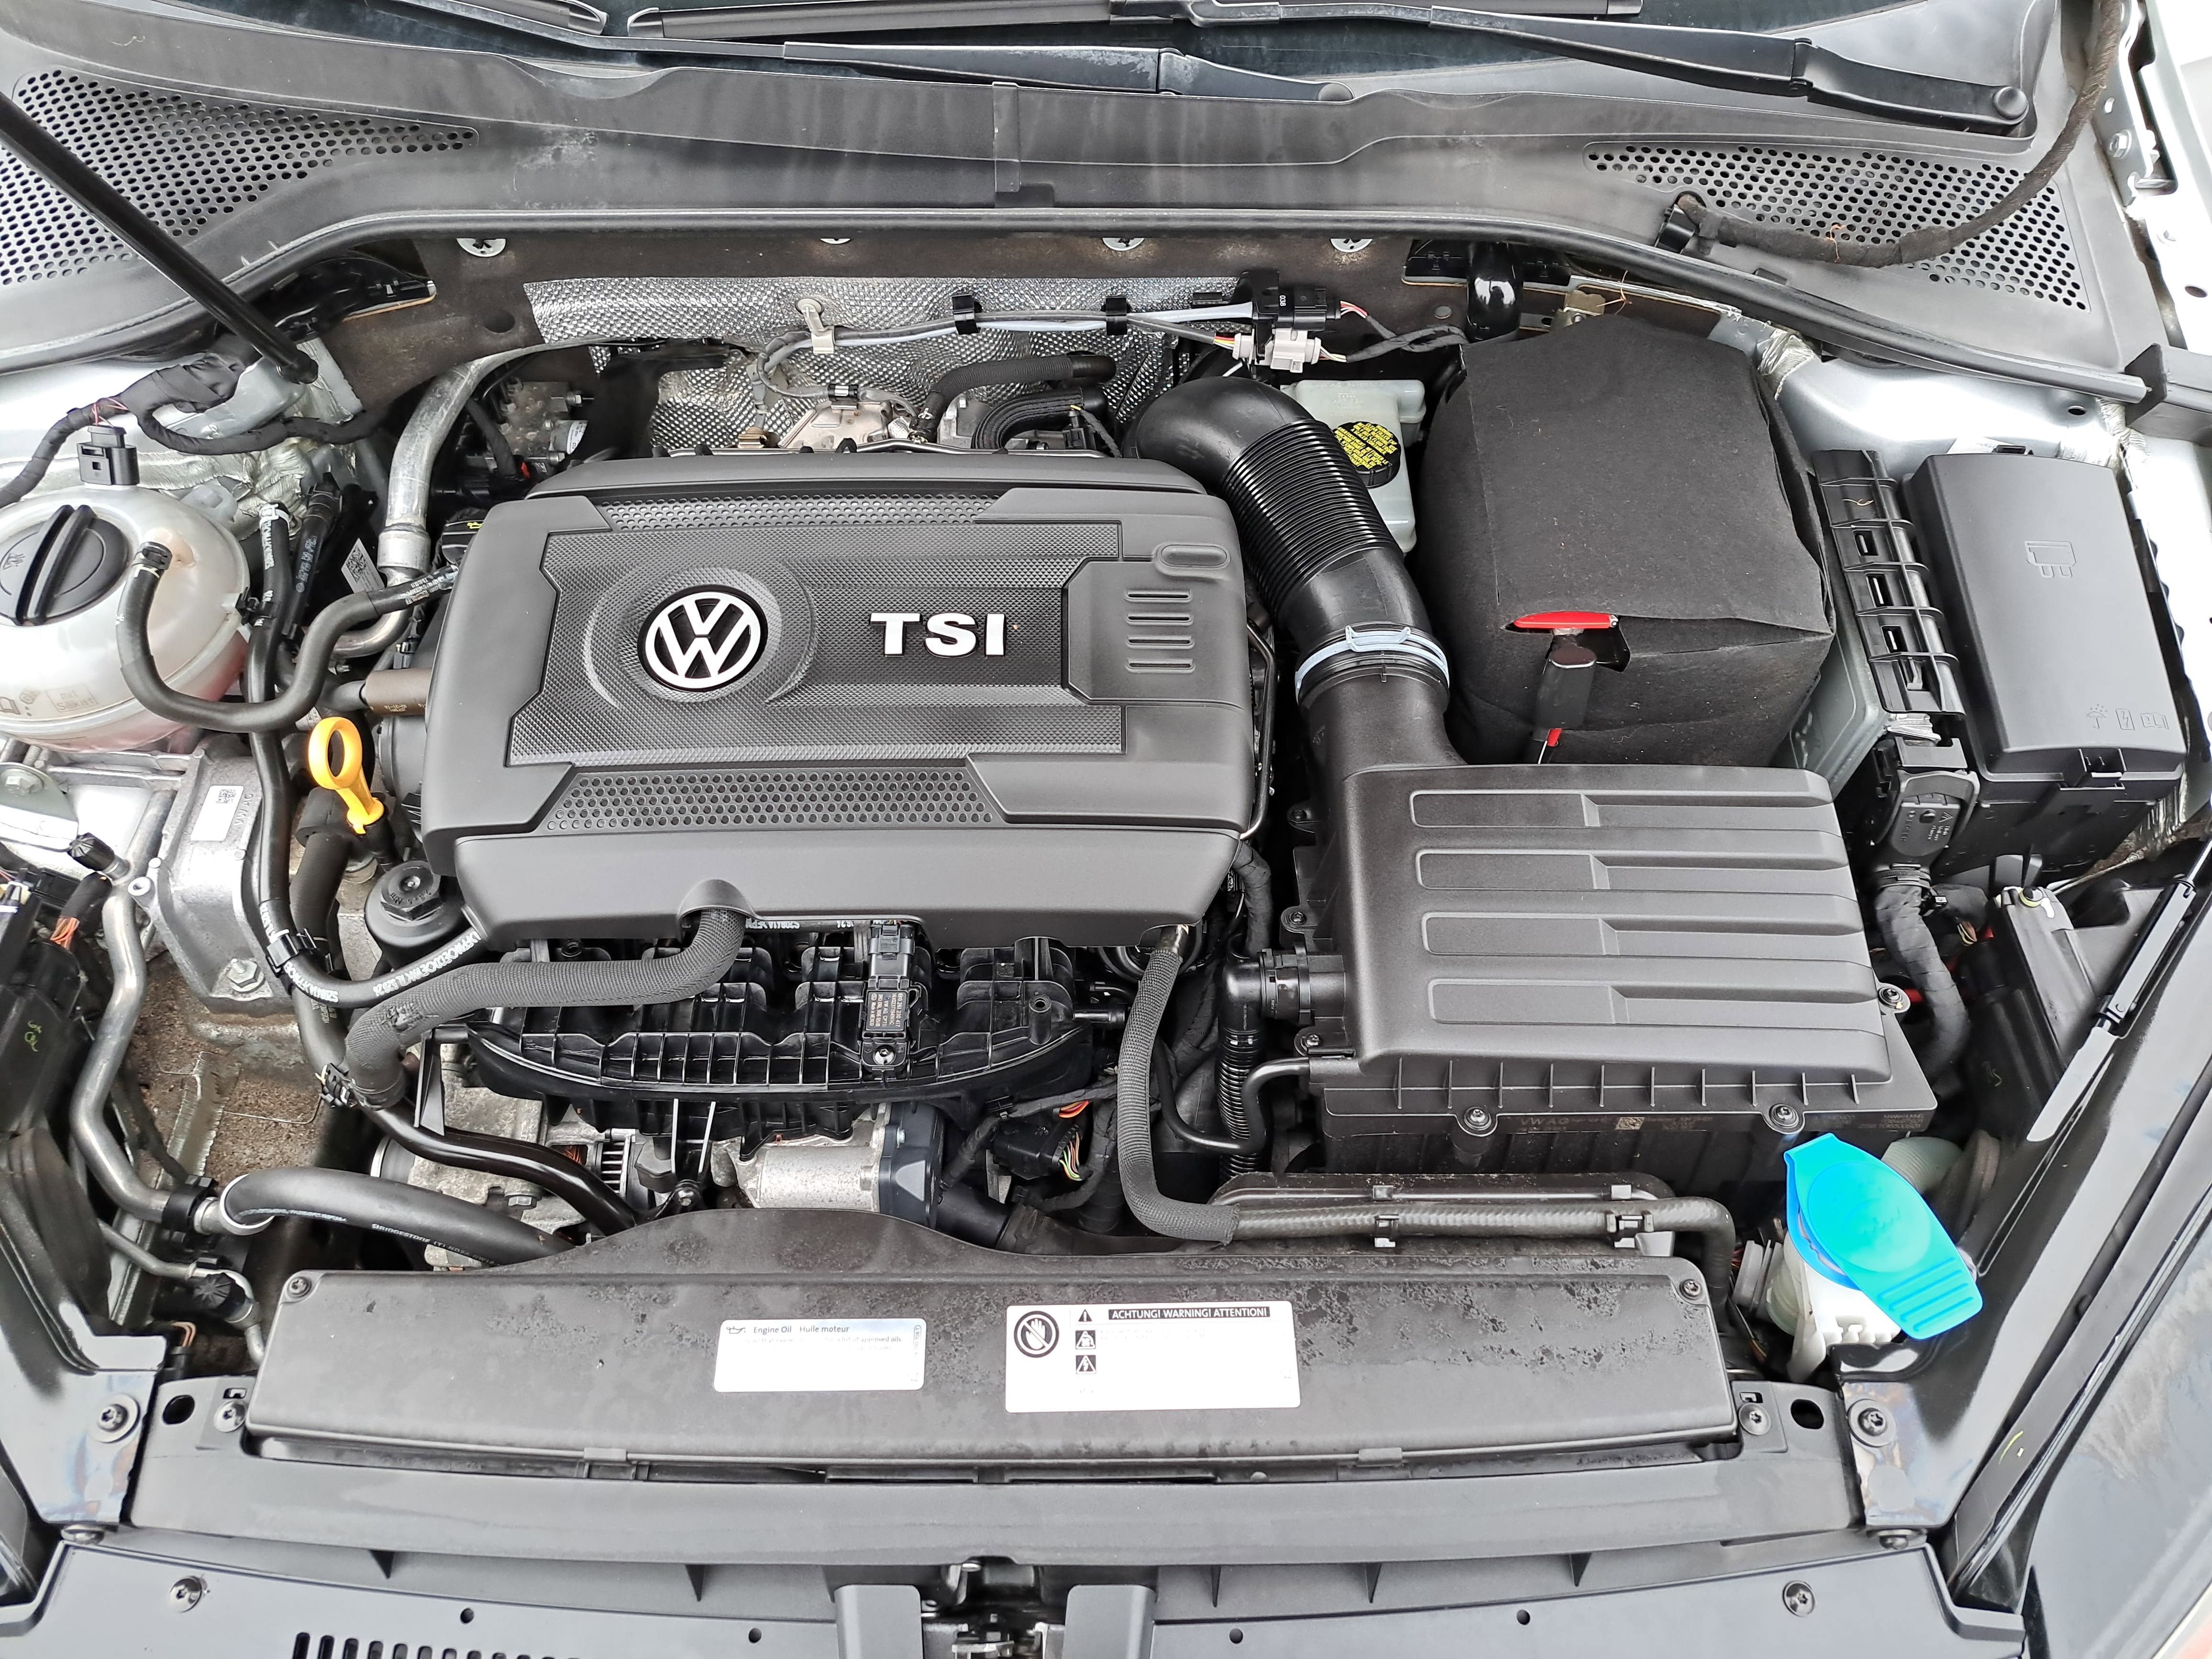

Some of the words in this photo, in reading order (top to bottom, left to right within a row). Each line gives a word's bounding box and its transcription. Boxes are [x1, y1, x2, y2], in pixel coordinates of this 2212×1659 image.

[870, 612, 1006, 657] TSI
[371, 1223, 431, 1243] BRIDGESTONE
[1112, 1310, 1161, 1320] ACHTUNG!
[1163, 1309, 1212, 1318] WARNING!
[1213, 1307, 1268, 1317] ATTENTION!
[753, 1326, 779, 1335] Engine
